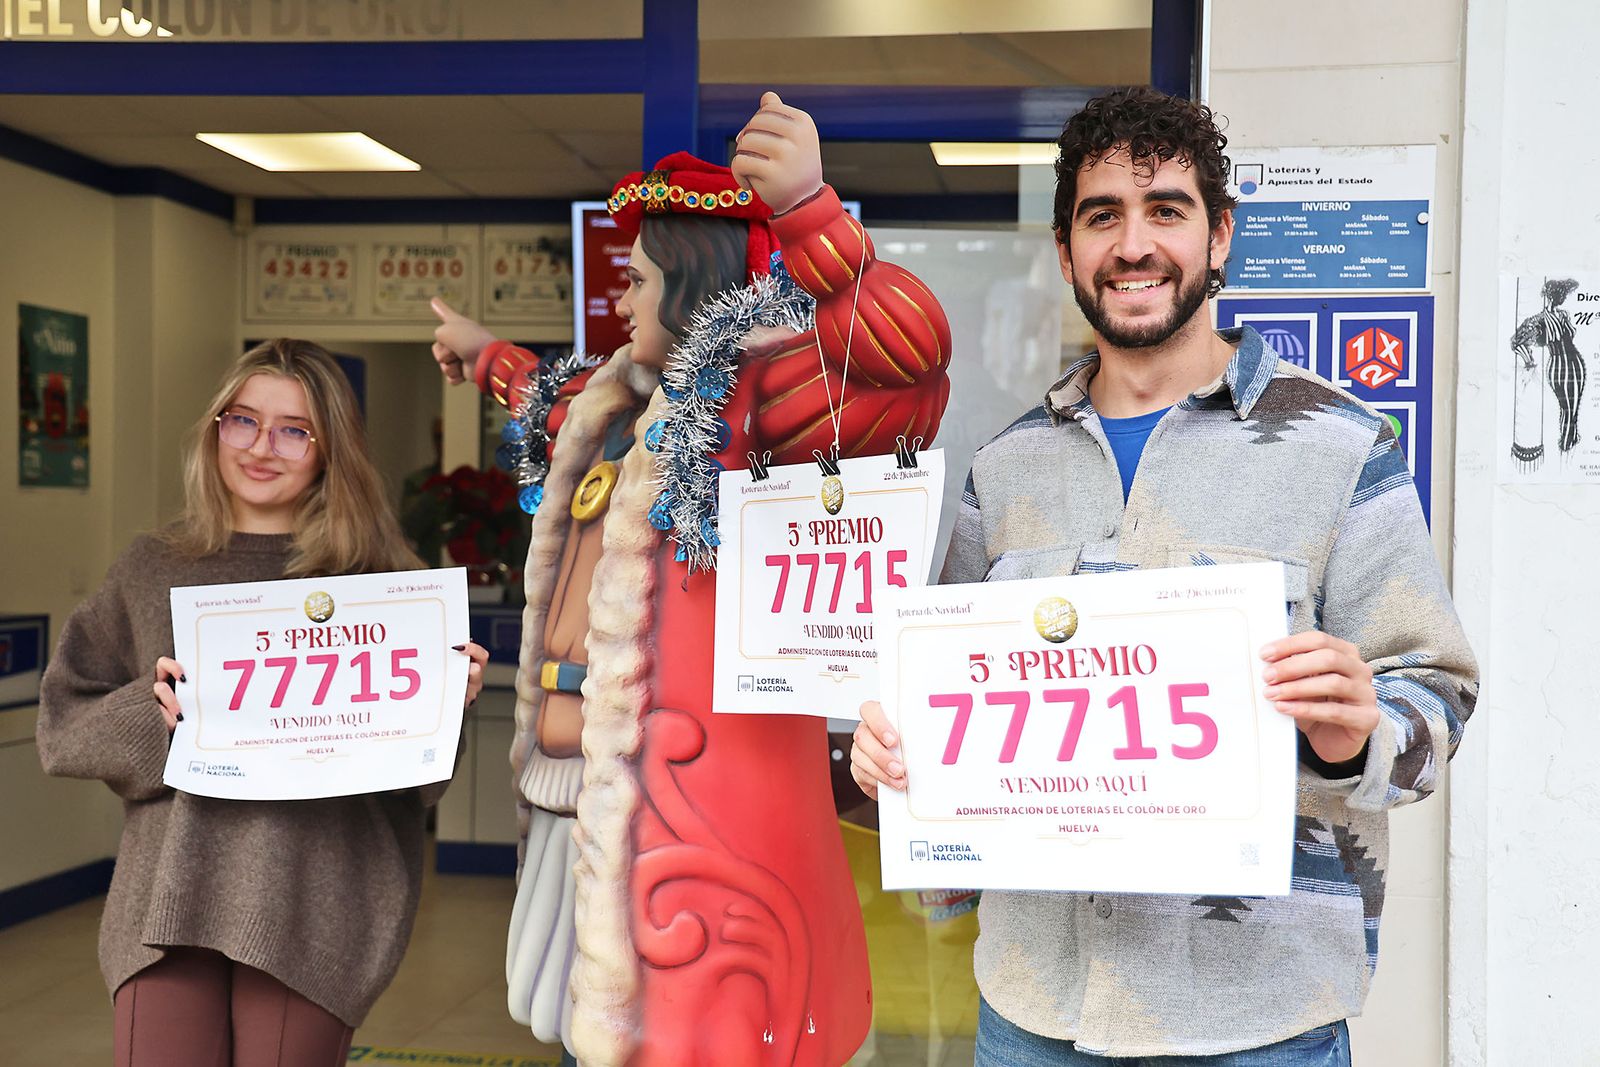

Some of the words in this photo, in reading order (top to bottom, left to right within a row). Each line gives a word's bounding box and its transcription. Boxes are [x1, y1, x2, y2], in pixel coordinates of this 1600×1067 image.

[1315, 167, 1321, 175] y
[1267, 179, 1314, 187] Apuestas
[1302, 202, 1351, 211] INVIERNO
[1303, 244, 1346, 254] VERANO
[1379, 335, 1399, 367] X
[883, 472, 891, 481] 22
[899, 470, 930, 480] Diciembre
[808, 516, 883, 546] PREMIO
[765, 550, 907, 614] 77715
[1186, 586, 1247, 600] Diciembre
[935, 602, 975, 615] Navidad
[284, 623, 386, 650] PREMIO
[803, 624, 844, 639] VENDIDO
[855, 650, 861, 658] EL
[827, 664, 848, 672] HUELVA
[1009, 643, 1158, 681] PREMIO
[223, 648, 422, 711] 77715
[756, 685, 794, 693] NACIONAL
[270, 716, 332, 730] VENDIDO
[928, 682, 1220, 766] 77715
[234, 737, 298, 747] ADMINISTRACION
[381, 729, 390, 737] DE
[391, 728, 407, 736] ORO
[1000, 776, 1089, 794] VENDIDO
[1095, 771, 1148, 796] AQUÍ
[955, 806, 1043, 816] ADMINISTRACION
[1046, 806, 1059, 815] DE
[1061, 805, 1111, 815] LOTERIAS
[1113, 806, 1125, 814] EL
[1127, 803, 1164, 814] COLÓN
[1167, 805, 1181, 814] DE
[1183, 805, 1207, 814] ORO
[1058, 824, 1100, 833] HUELVA
[932, 842, 972, 852] LOTERÍA
[933, 854, 982, 862] NACIONAL
